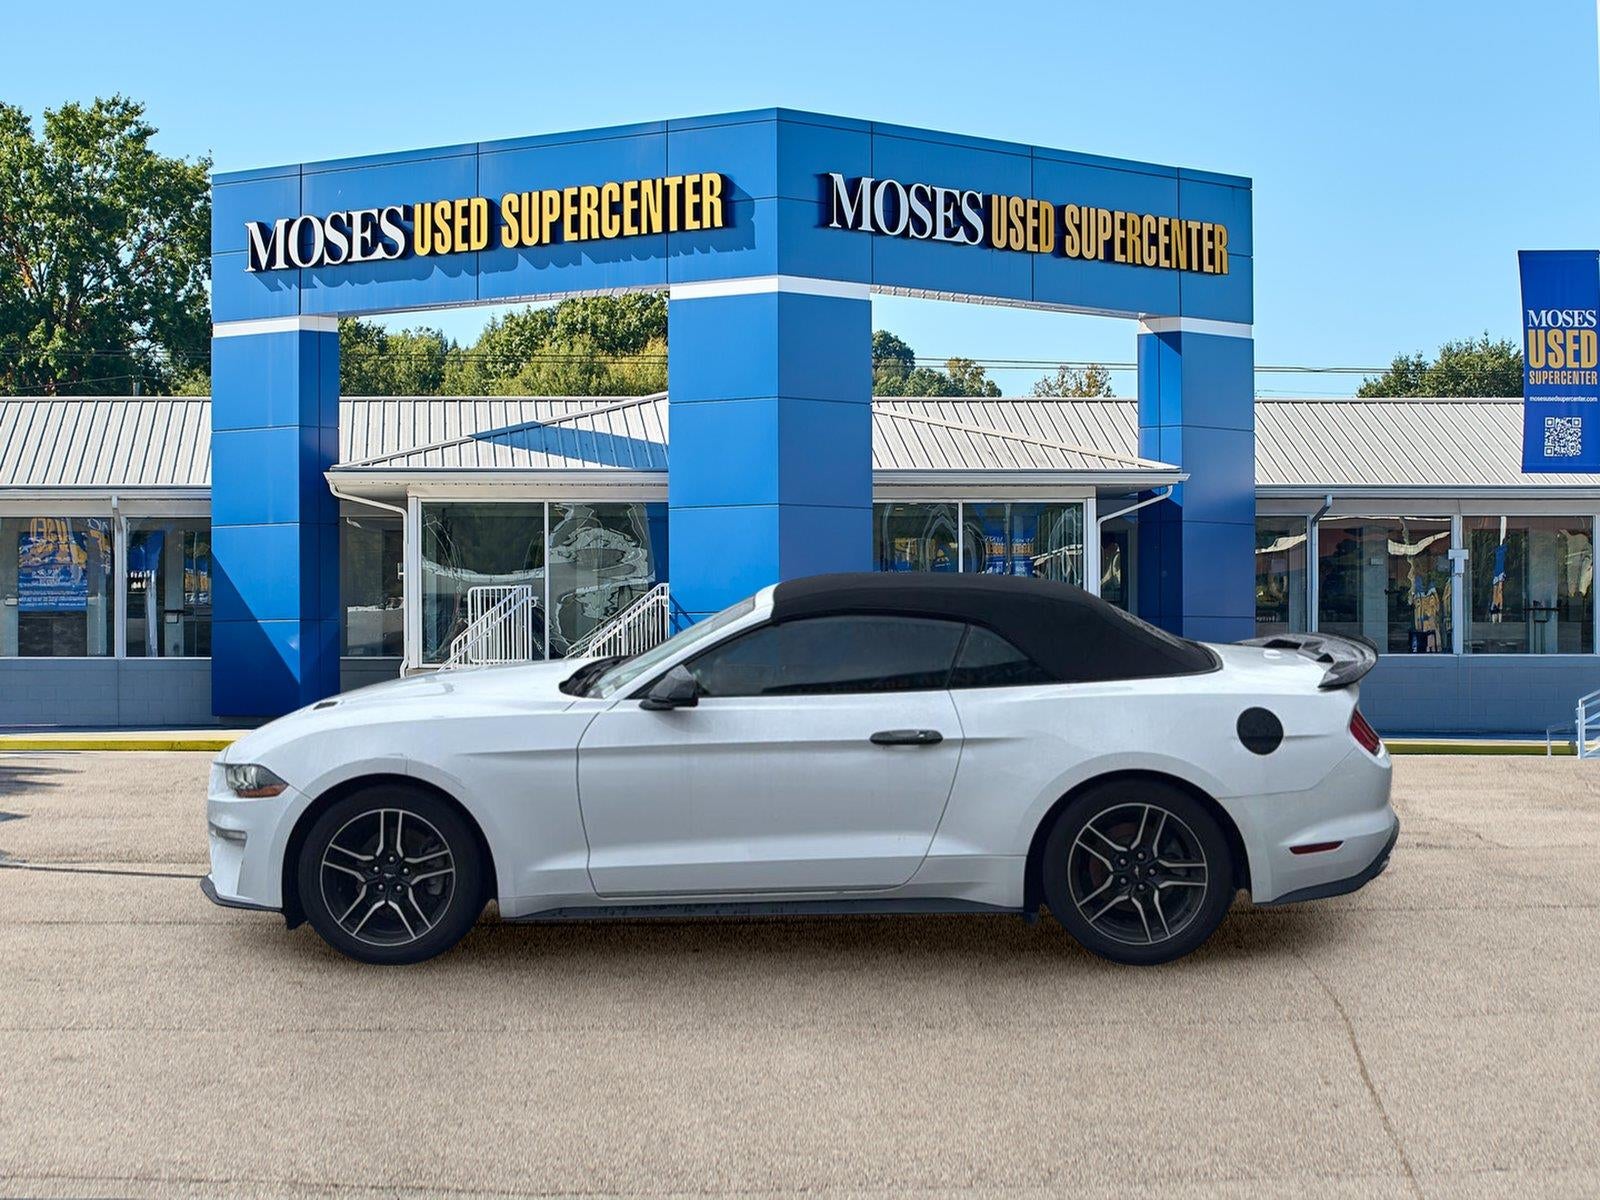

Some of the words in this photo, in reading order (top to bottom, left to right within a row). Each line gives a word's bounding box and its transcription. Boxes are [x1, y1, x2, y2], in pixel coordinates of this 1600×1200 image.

[244, 205, 407, 273] MOSES
[413, 197, 489, 256] USED
[501, 173, 723, 248] SUPERCENTER
[828, 173, 984, 245] MOSES
[991, 195, 1055, 254] USED
[1065, 205, 1229, 274] SUPERCENTER
[1528, 310, 1596, 327] MOSES
[1528, 330, 1597, 368] USED
[1529, 371, 1597, 385] SUPERCENTER
